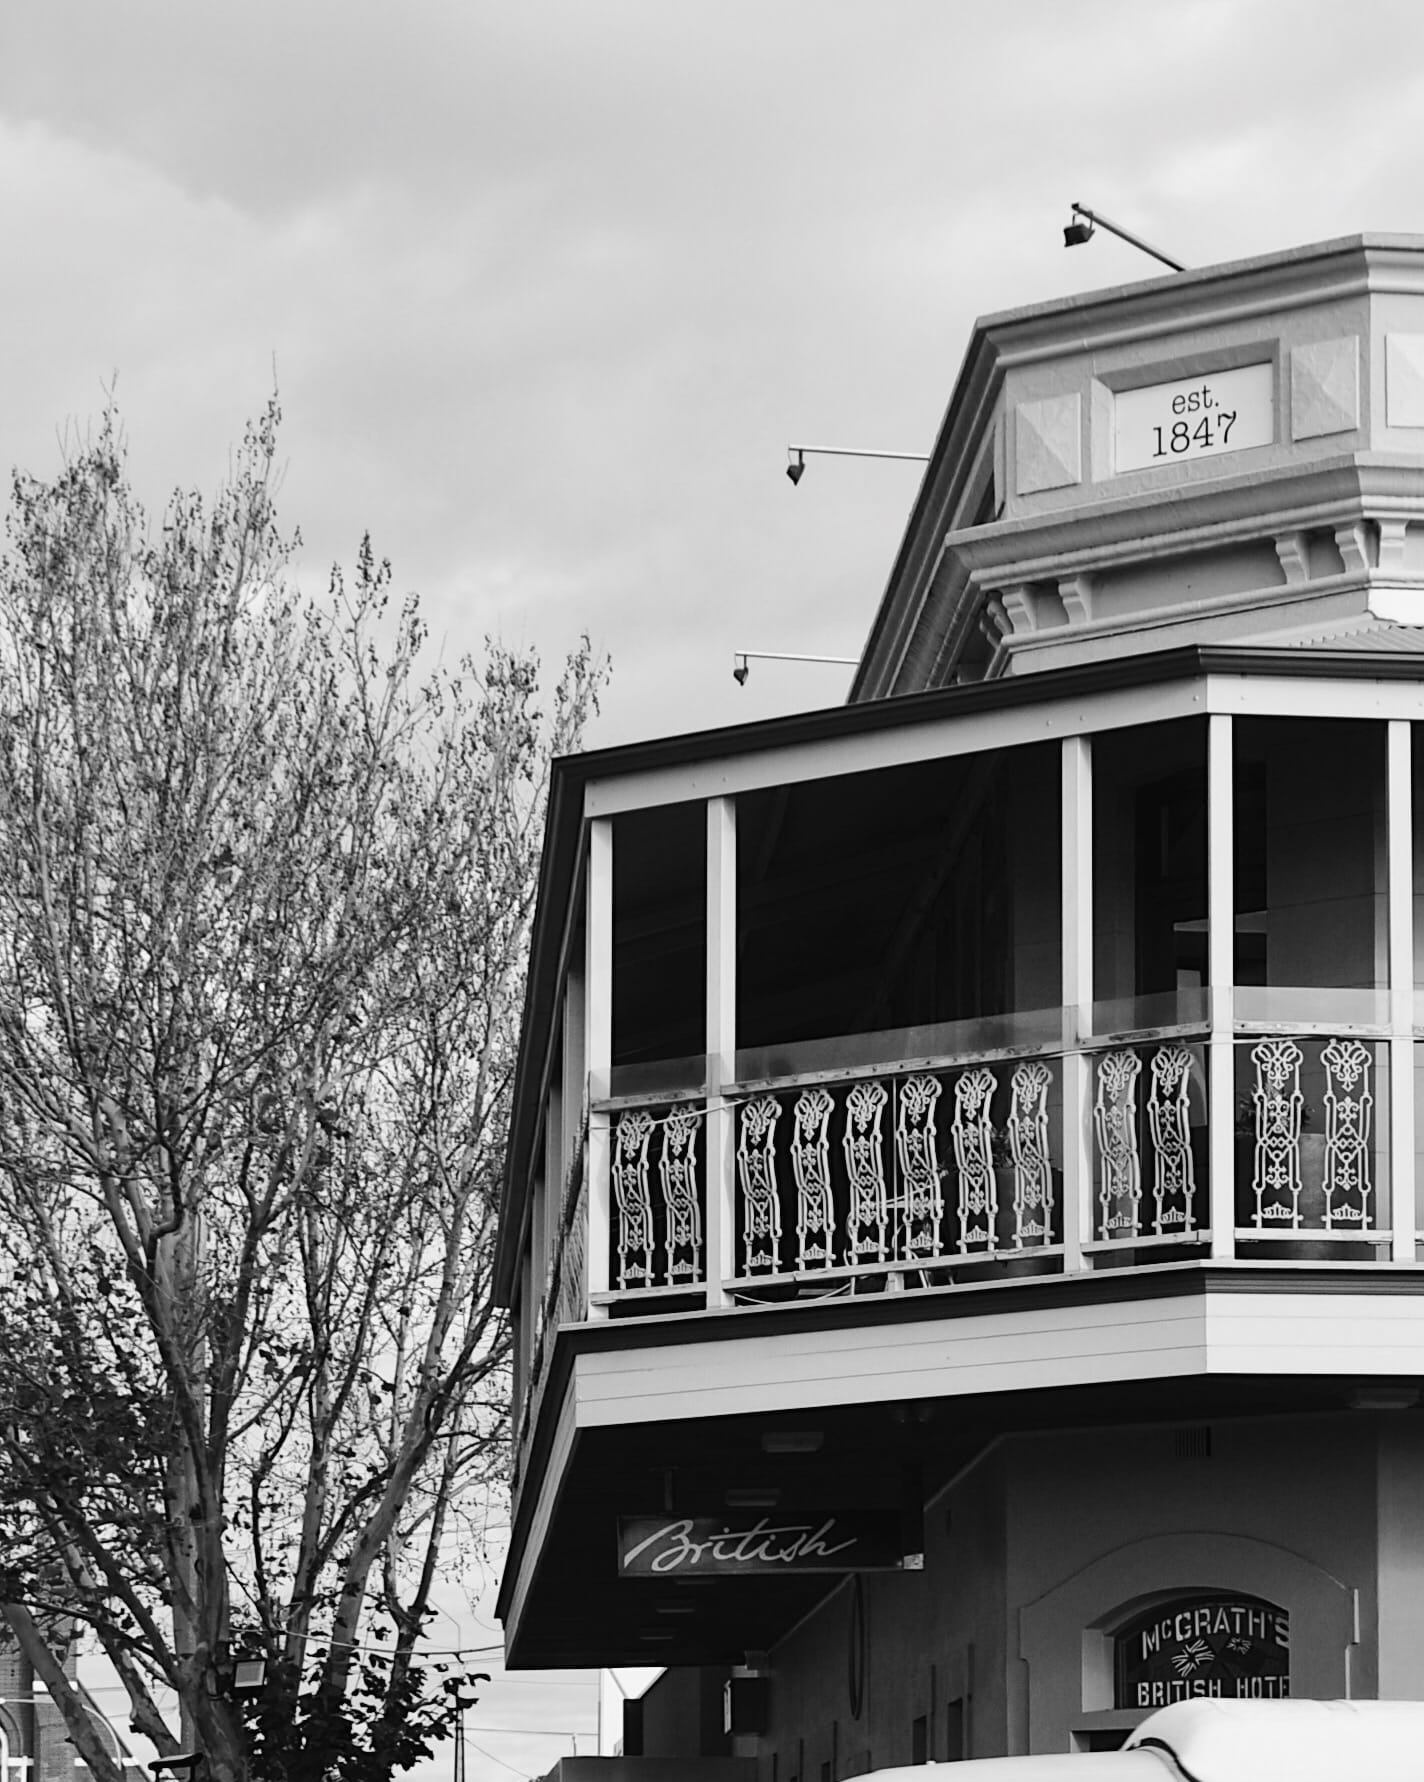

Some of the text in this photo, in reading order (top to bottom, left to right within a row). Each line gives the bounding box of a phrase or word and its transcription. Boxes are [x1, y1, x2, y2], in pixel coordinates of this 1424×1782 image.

[1171, 384, 1219, 415] est.
[1152, 410, 1237, 458] 1847
[623, 1518, 858, 1572] British
[1137, 1678, 1222, 1707] BRITISH
